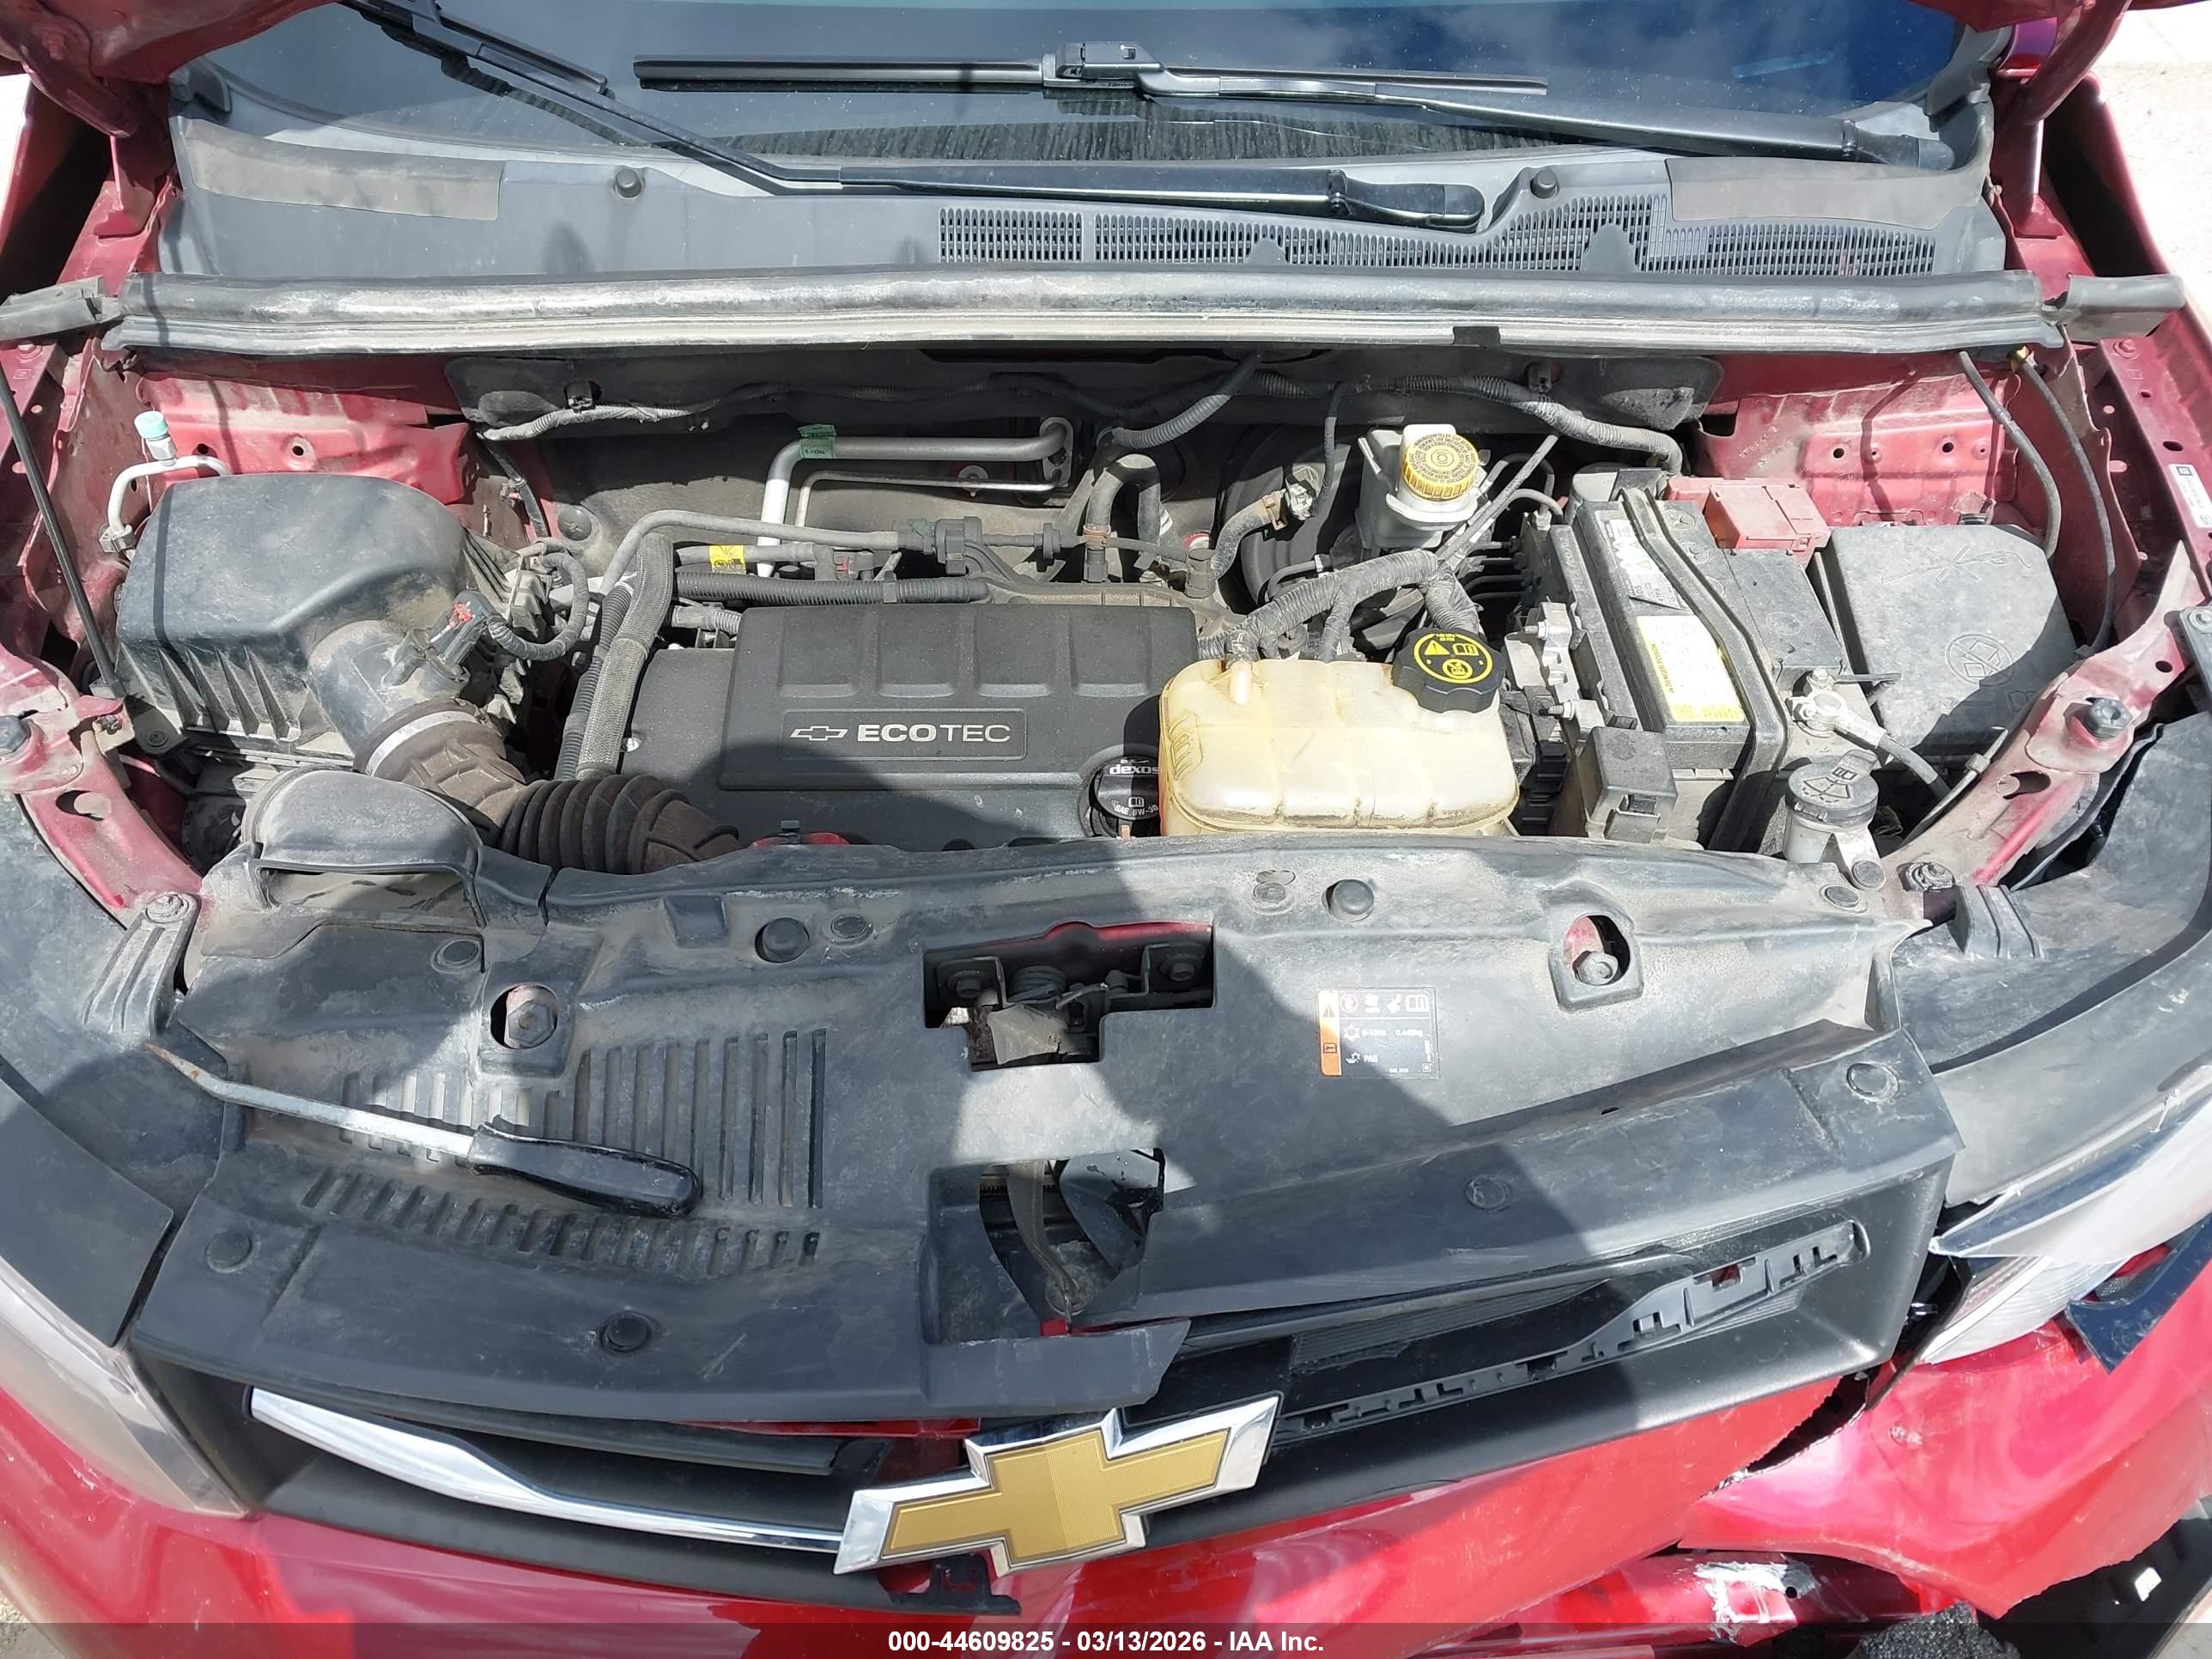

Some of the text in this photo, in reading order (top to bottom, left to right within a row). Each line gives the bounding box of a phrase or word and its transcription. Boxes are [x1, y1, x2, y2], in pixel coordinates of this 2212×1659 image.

[857, 723, 1011, 743] ECOTEC
[1109, 763, 1161, 775] dexos
[1114, 804, 1130, 815] SAE
